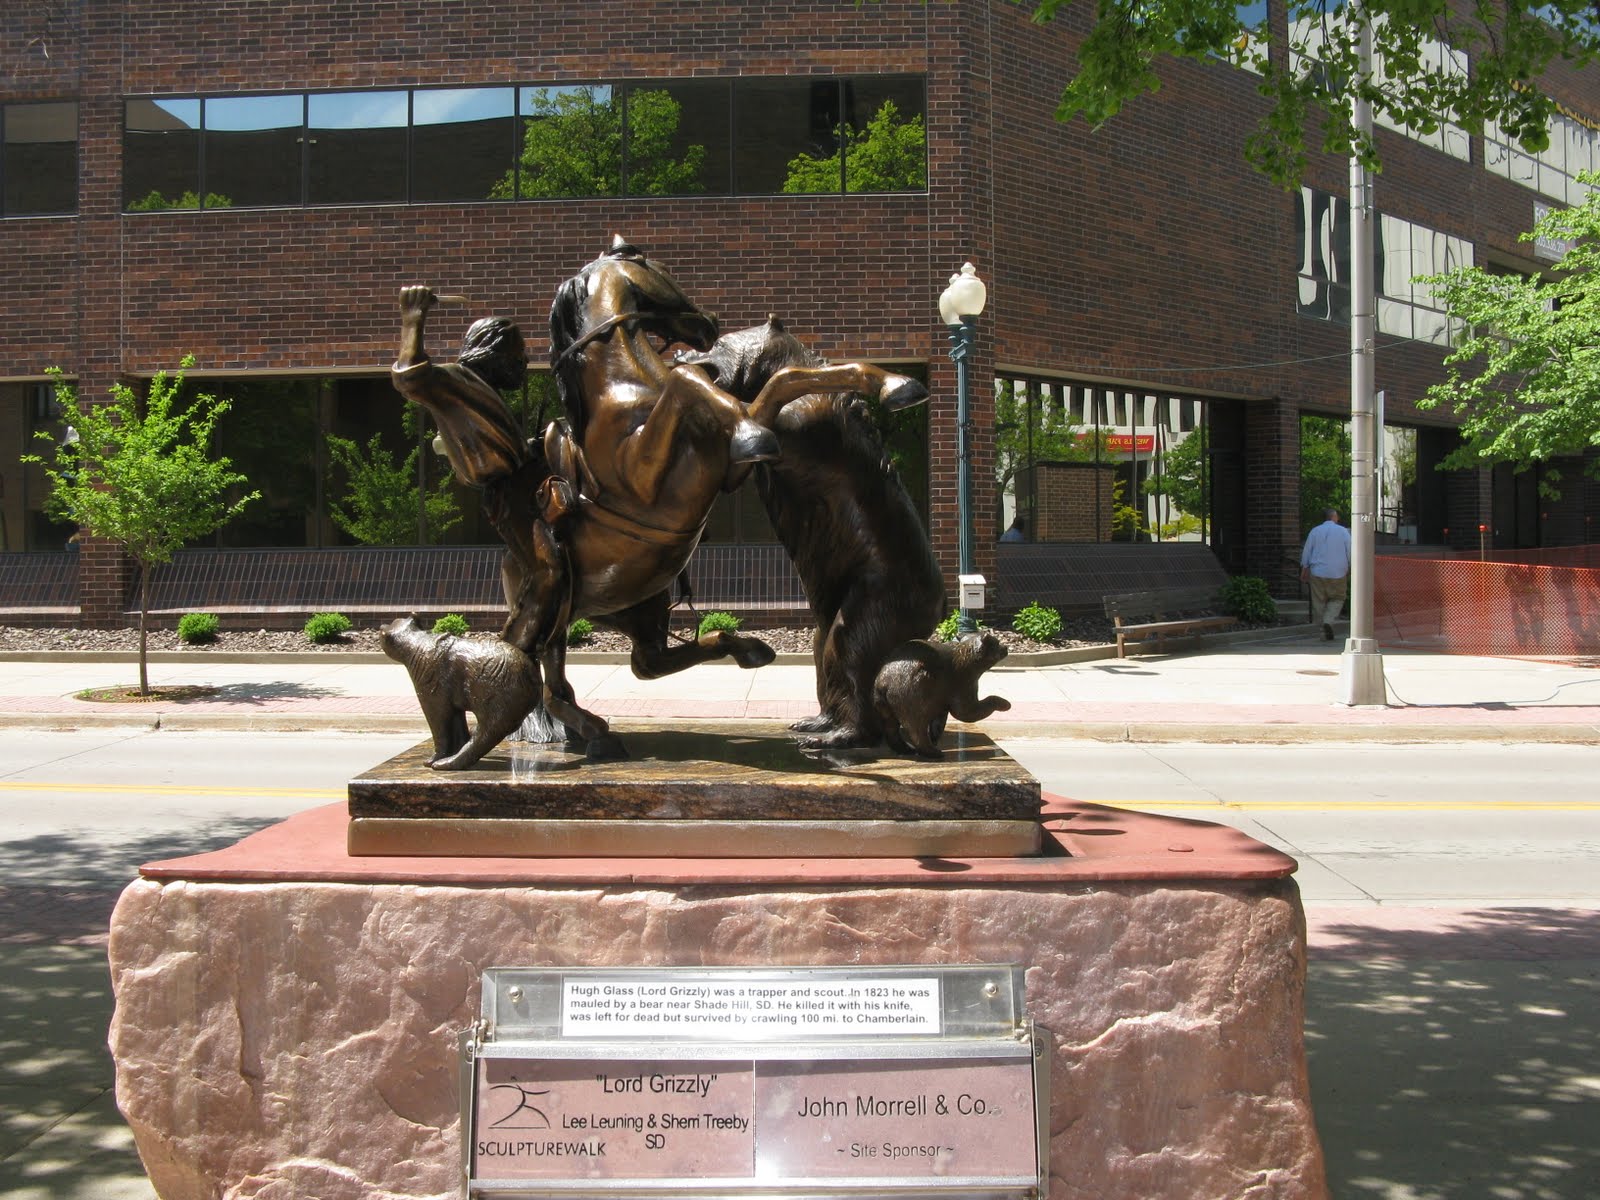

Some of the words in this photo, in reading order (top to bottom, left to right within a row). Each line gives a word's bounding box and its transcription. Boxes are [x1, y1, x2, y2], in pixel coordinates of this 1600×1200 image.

[571, 986, 599, 997] Hugh
[603, 986, 633, 995] Glass
[638, 986, 666, 997] (Lord
[670, 987, 710, 998] Grizzly)
[748, 988, 787, 999] trapper
[791, 988, 810, 997] and
[865, 988, 888, 997] 1823
[892, 988, 905, 997] he
[908, 989, 929, 997] was
[571, 1000, 610, 1008] mauled
[614, 1000, 626, 1010] by
[640, 1000, 663, 1008] bear
[694, 1000, 728, 1009] Shade
[756, 1001, 774, 1009] SD.
[778, 1001, 792, 1009] He
[796, 1001, 824, 1009] killed
[828, 1001, 835, 1009] it
[838, 1001, 860, 1009] with
[864, 1001, 879, 1009] his
[884, 1001, 912, 1011] knife,
[595, 1012, 612, 1021] left
[615, 1013, 629, 1021] for
[633, 1013, 660, 1022] dead
[664, 1013, 681, 1022] but
[684, 1013, 730, 1022] survived
[734, 1014, 747, 1024] by
[752, 1014, 797, 1024] crawling
[801, 1014, 819, 1022] 100
[823, 1014, 838, 1022] mi.
[857, 1014, 928, 1023] Chamberlain.
[596, 1075, 643, 1093] "Lord
[649, 1074, 717, 1097] Grizzly"
[798, 1096, 848, 1117] John
[856, 1095, 926, 1116] Morrell
[935, 1094, 949, 1115] &
[957, 1094, 992, 1115] Co.
[562, 1114, 587, 1128] Lee
[591, 1114, 643, 1132] Leuning
[648, 1114, 658, 1129] &
[703, 1114, 749, 1132] Treeby
[478, 1142, 606, 1156] SCULPTUREWALK
[645, 1134, 665, 1149] SD
[850, 1143, 877, 1157] Site
[882, 1143, 941, 1159] Sponsor
